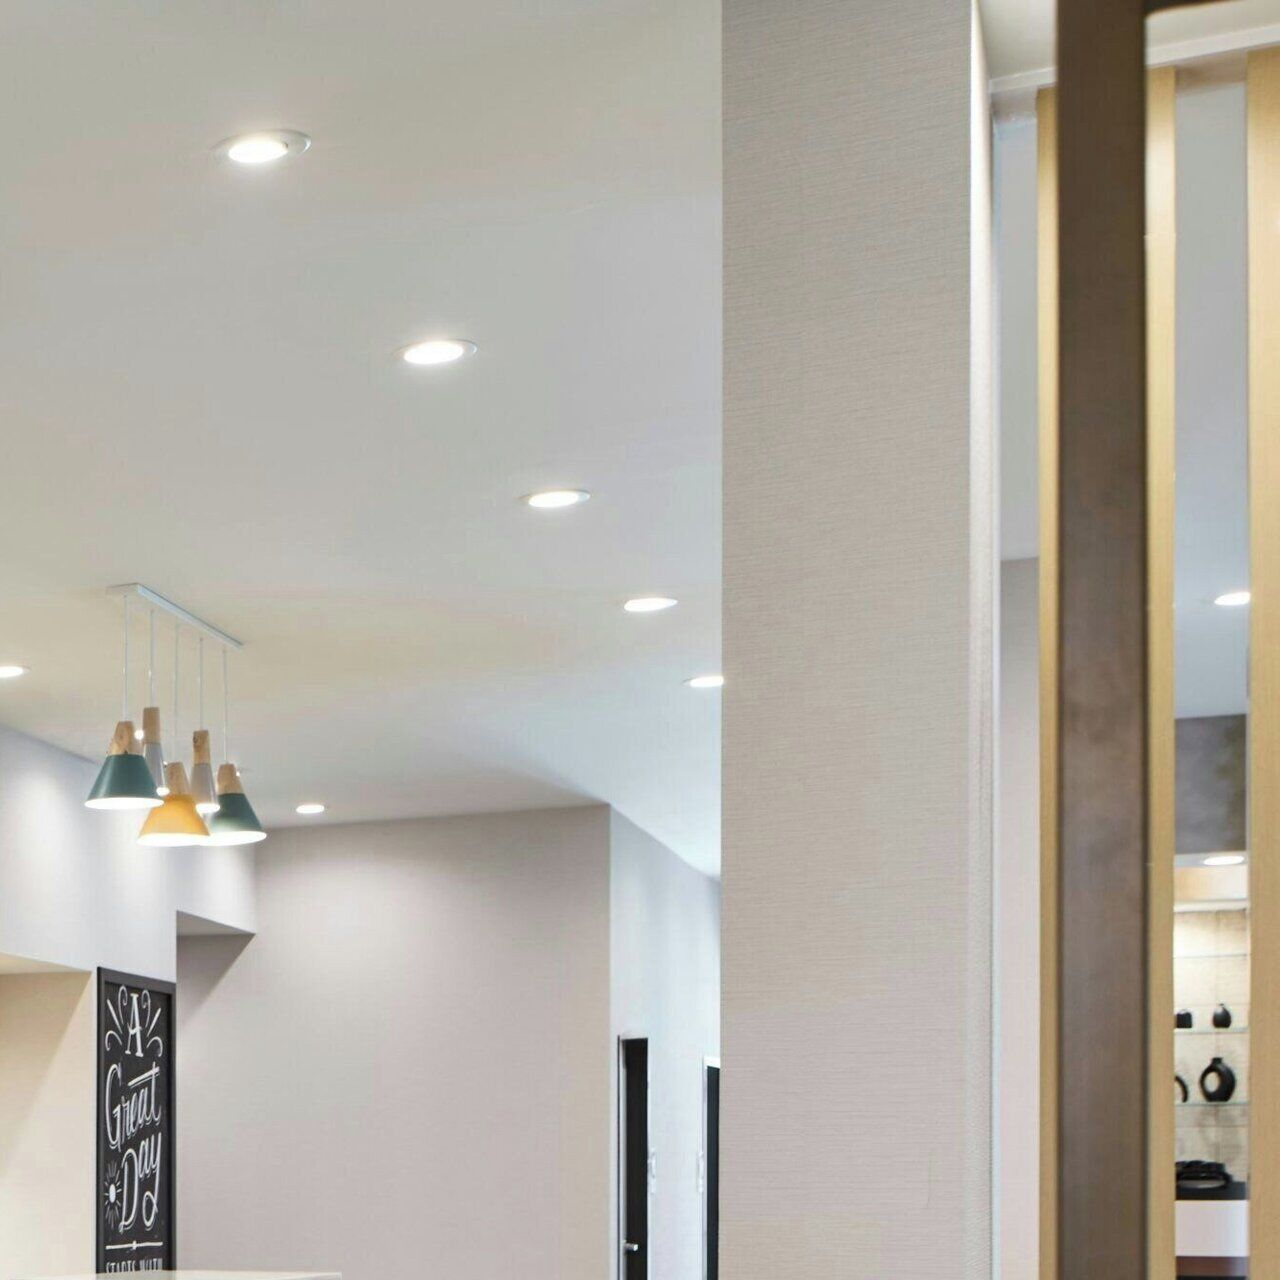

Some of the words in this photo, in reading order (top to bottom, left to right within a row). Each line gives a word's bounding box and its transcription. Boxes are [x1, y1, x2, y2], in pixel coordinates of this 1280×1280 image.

[125, 993, 143, 1058] A
[105, 1062, 161, 1152] Great
[118, 1131, 162, 1234] Day
